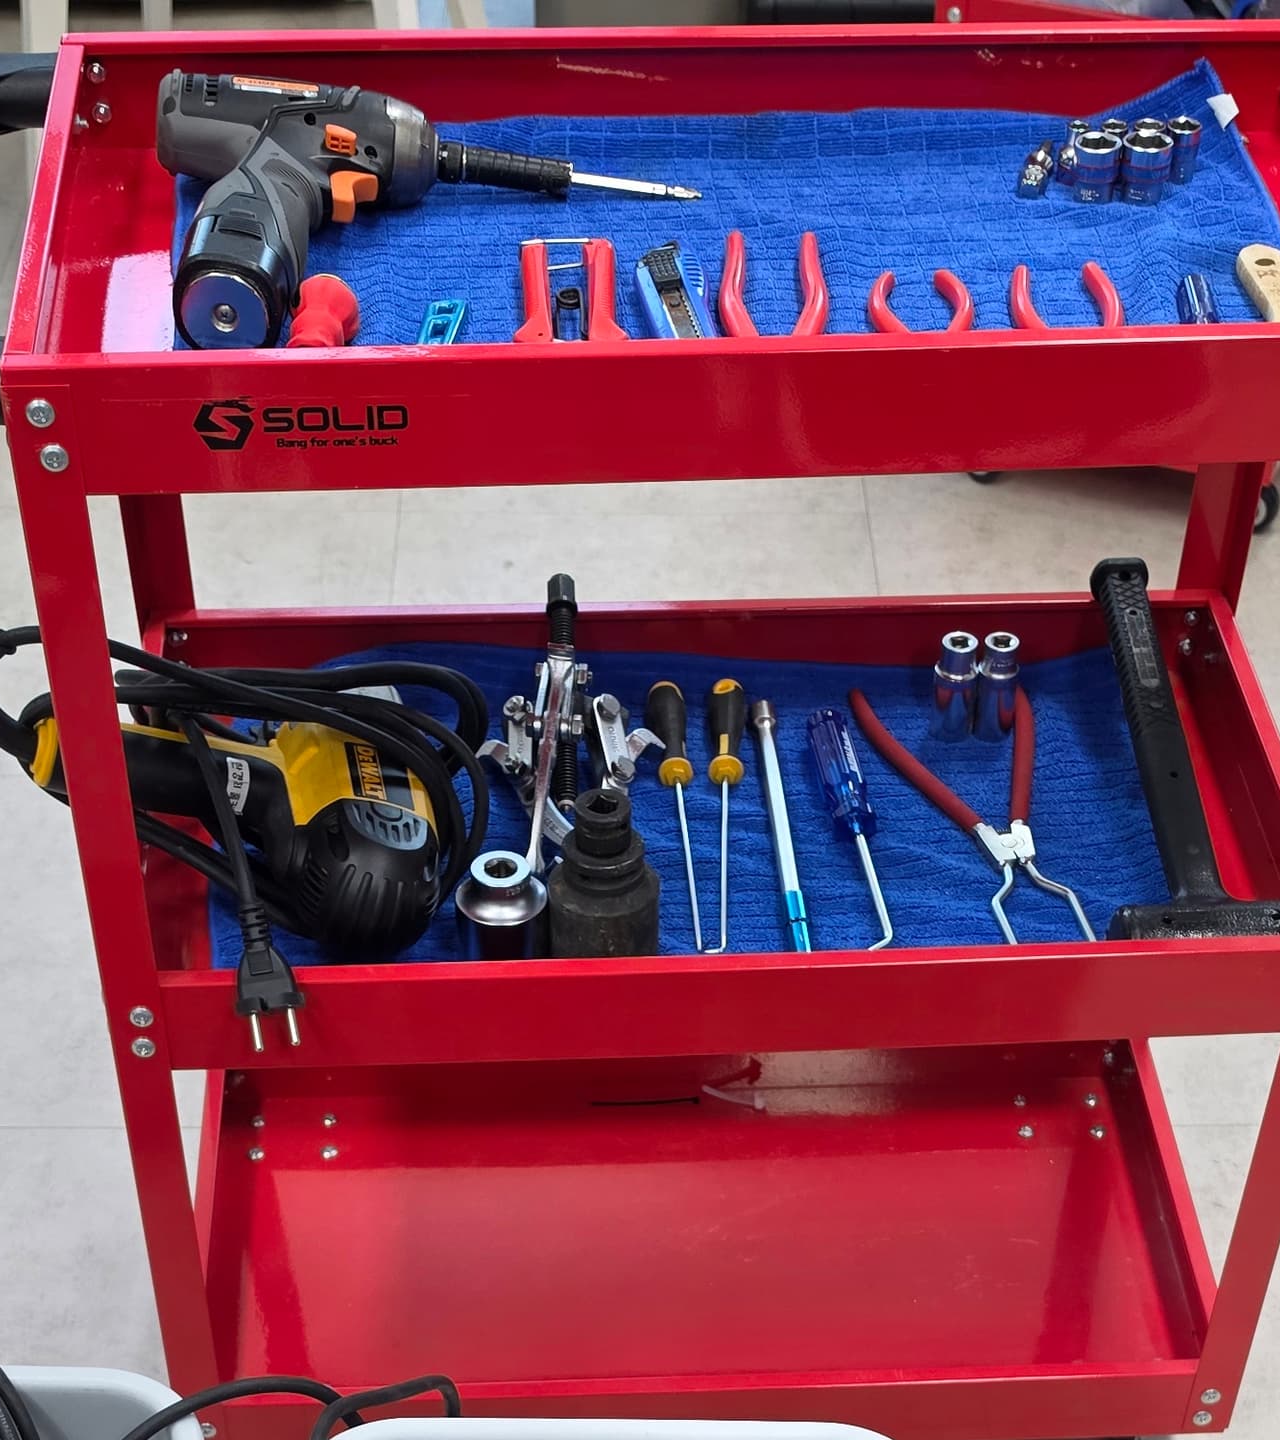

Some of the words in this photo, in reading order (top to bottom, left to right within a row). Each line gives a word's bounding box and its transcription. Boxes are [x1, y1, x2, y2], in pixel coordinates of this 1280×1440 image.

[262, 405, 409, 433] SOLID
[276, 438, 308, 450] Bang
[310, 437, 330, 448] for
[332, 436, 366, 447] one's
[369, 435, 399, 446] buck
